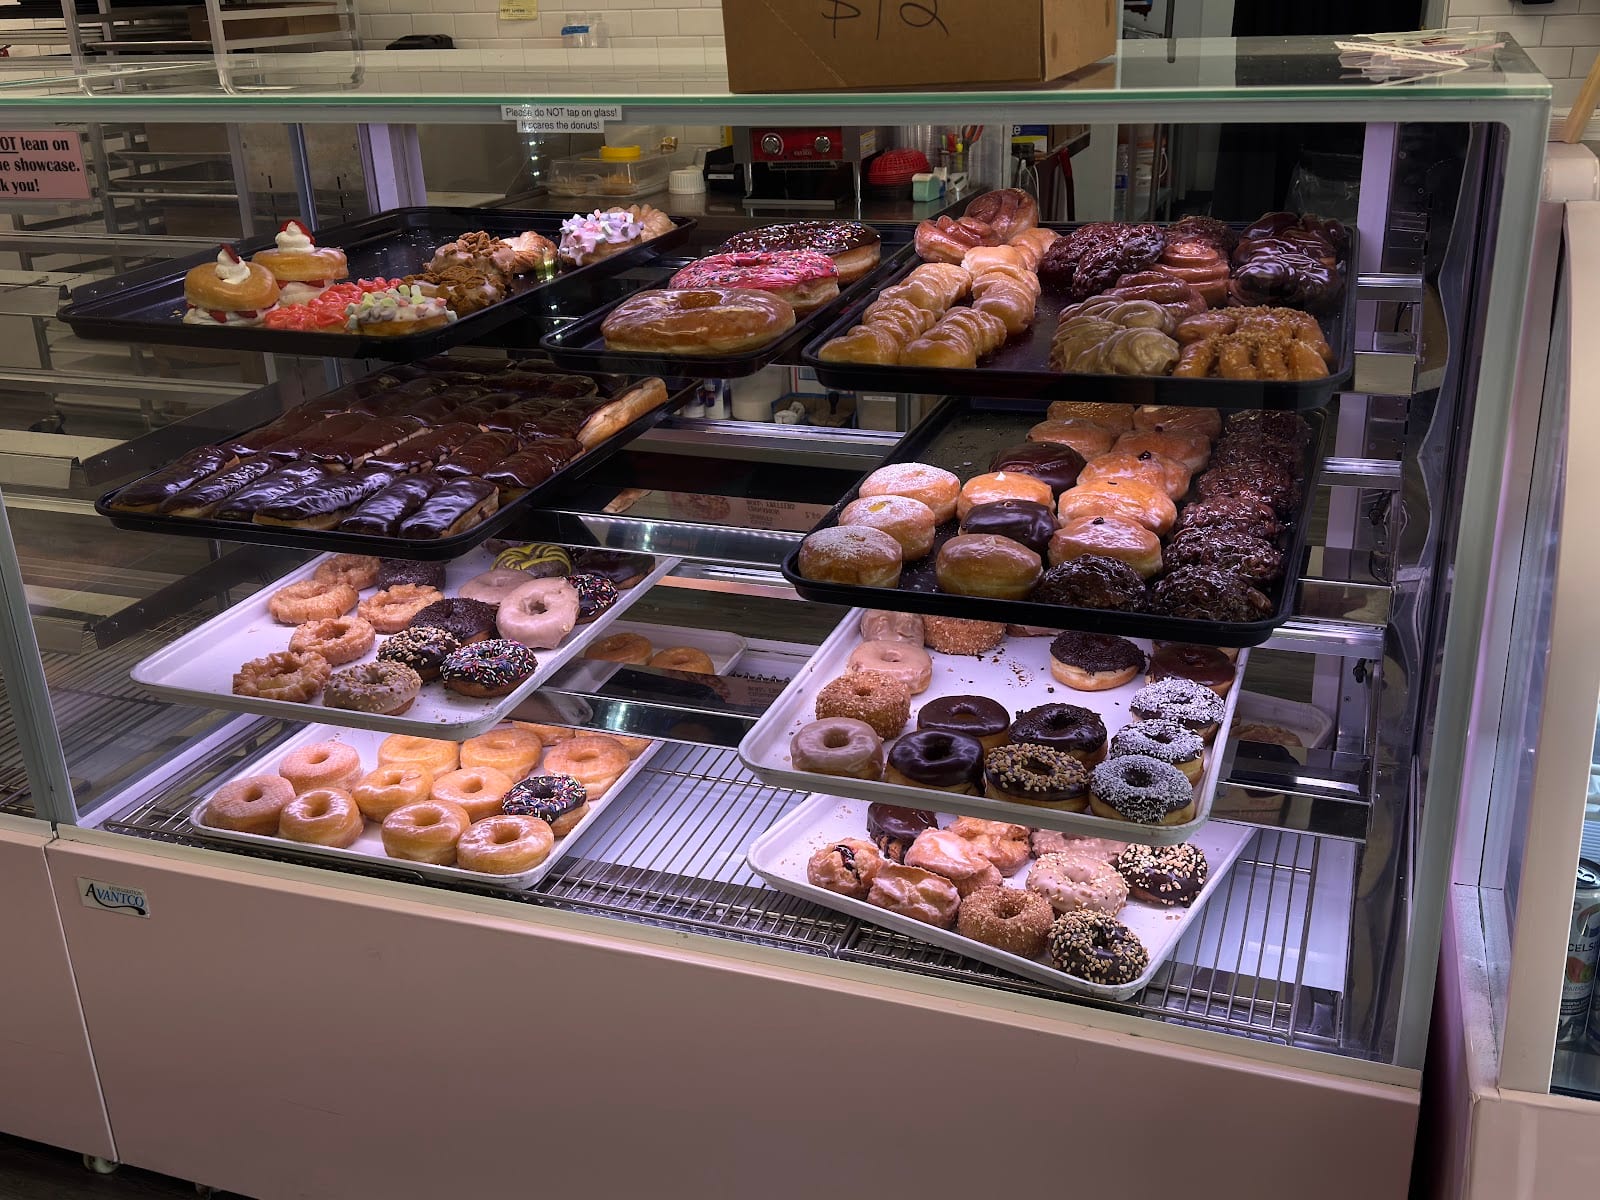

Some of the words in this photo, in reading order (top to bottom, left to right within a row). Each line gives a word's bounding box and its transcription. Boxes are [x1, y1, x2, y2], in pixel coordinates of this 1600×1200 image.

[505, 107, 533, 118] Please
[534, 107, 545, 117] do
[546, 107, 565, 117] NOT
[567, 108, 580, 120] tap
[581, 109, 592, 118] on
[594, 107, 618, 119] glass!
[528, 122, 555, 130] scares
[556, 121, 569, 130] the
[570, 120, 600, 130] donuts!
[0, 136, 17, 151] OT
[20, 136, 49, 151] lean
[52, 139, 70, 151] on
[14, 157, 81, 172] showcase.
[11, 178, 40, 195] you!
[84, 882, 146, 914] AVANTCO
[1567, 942, 1595, 953] CELS
